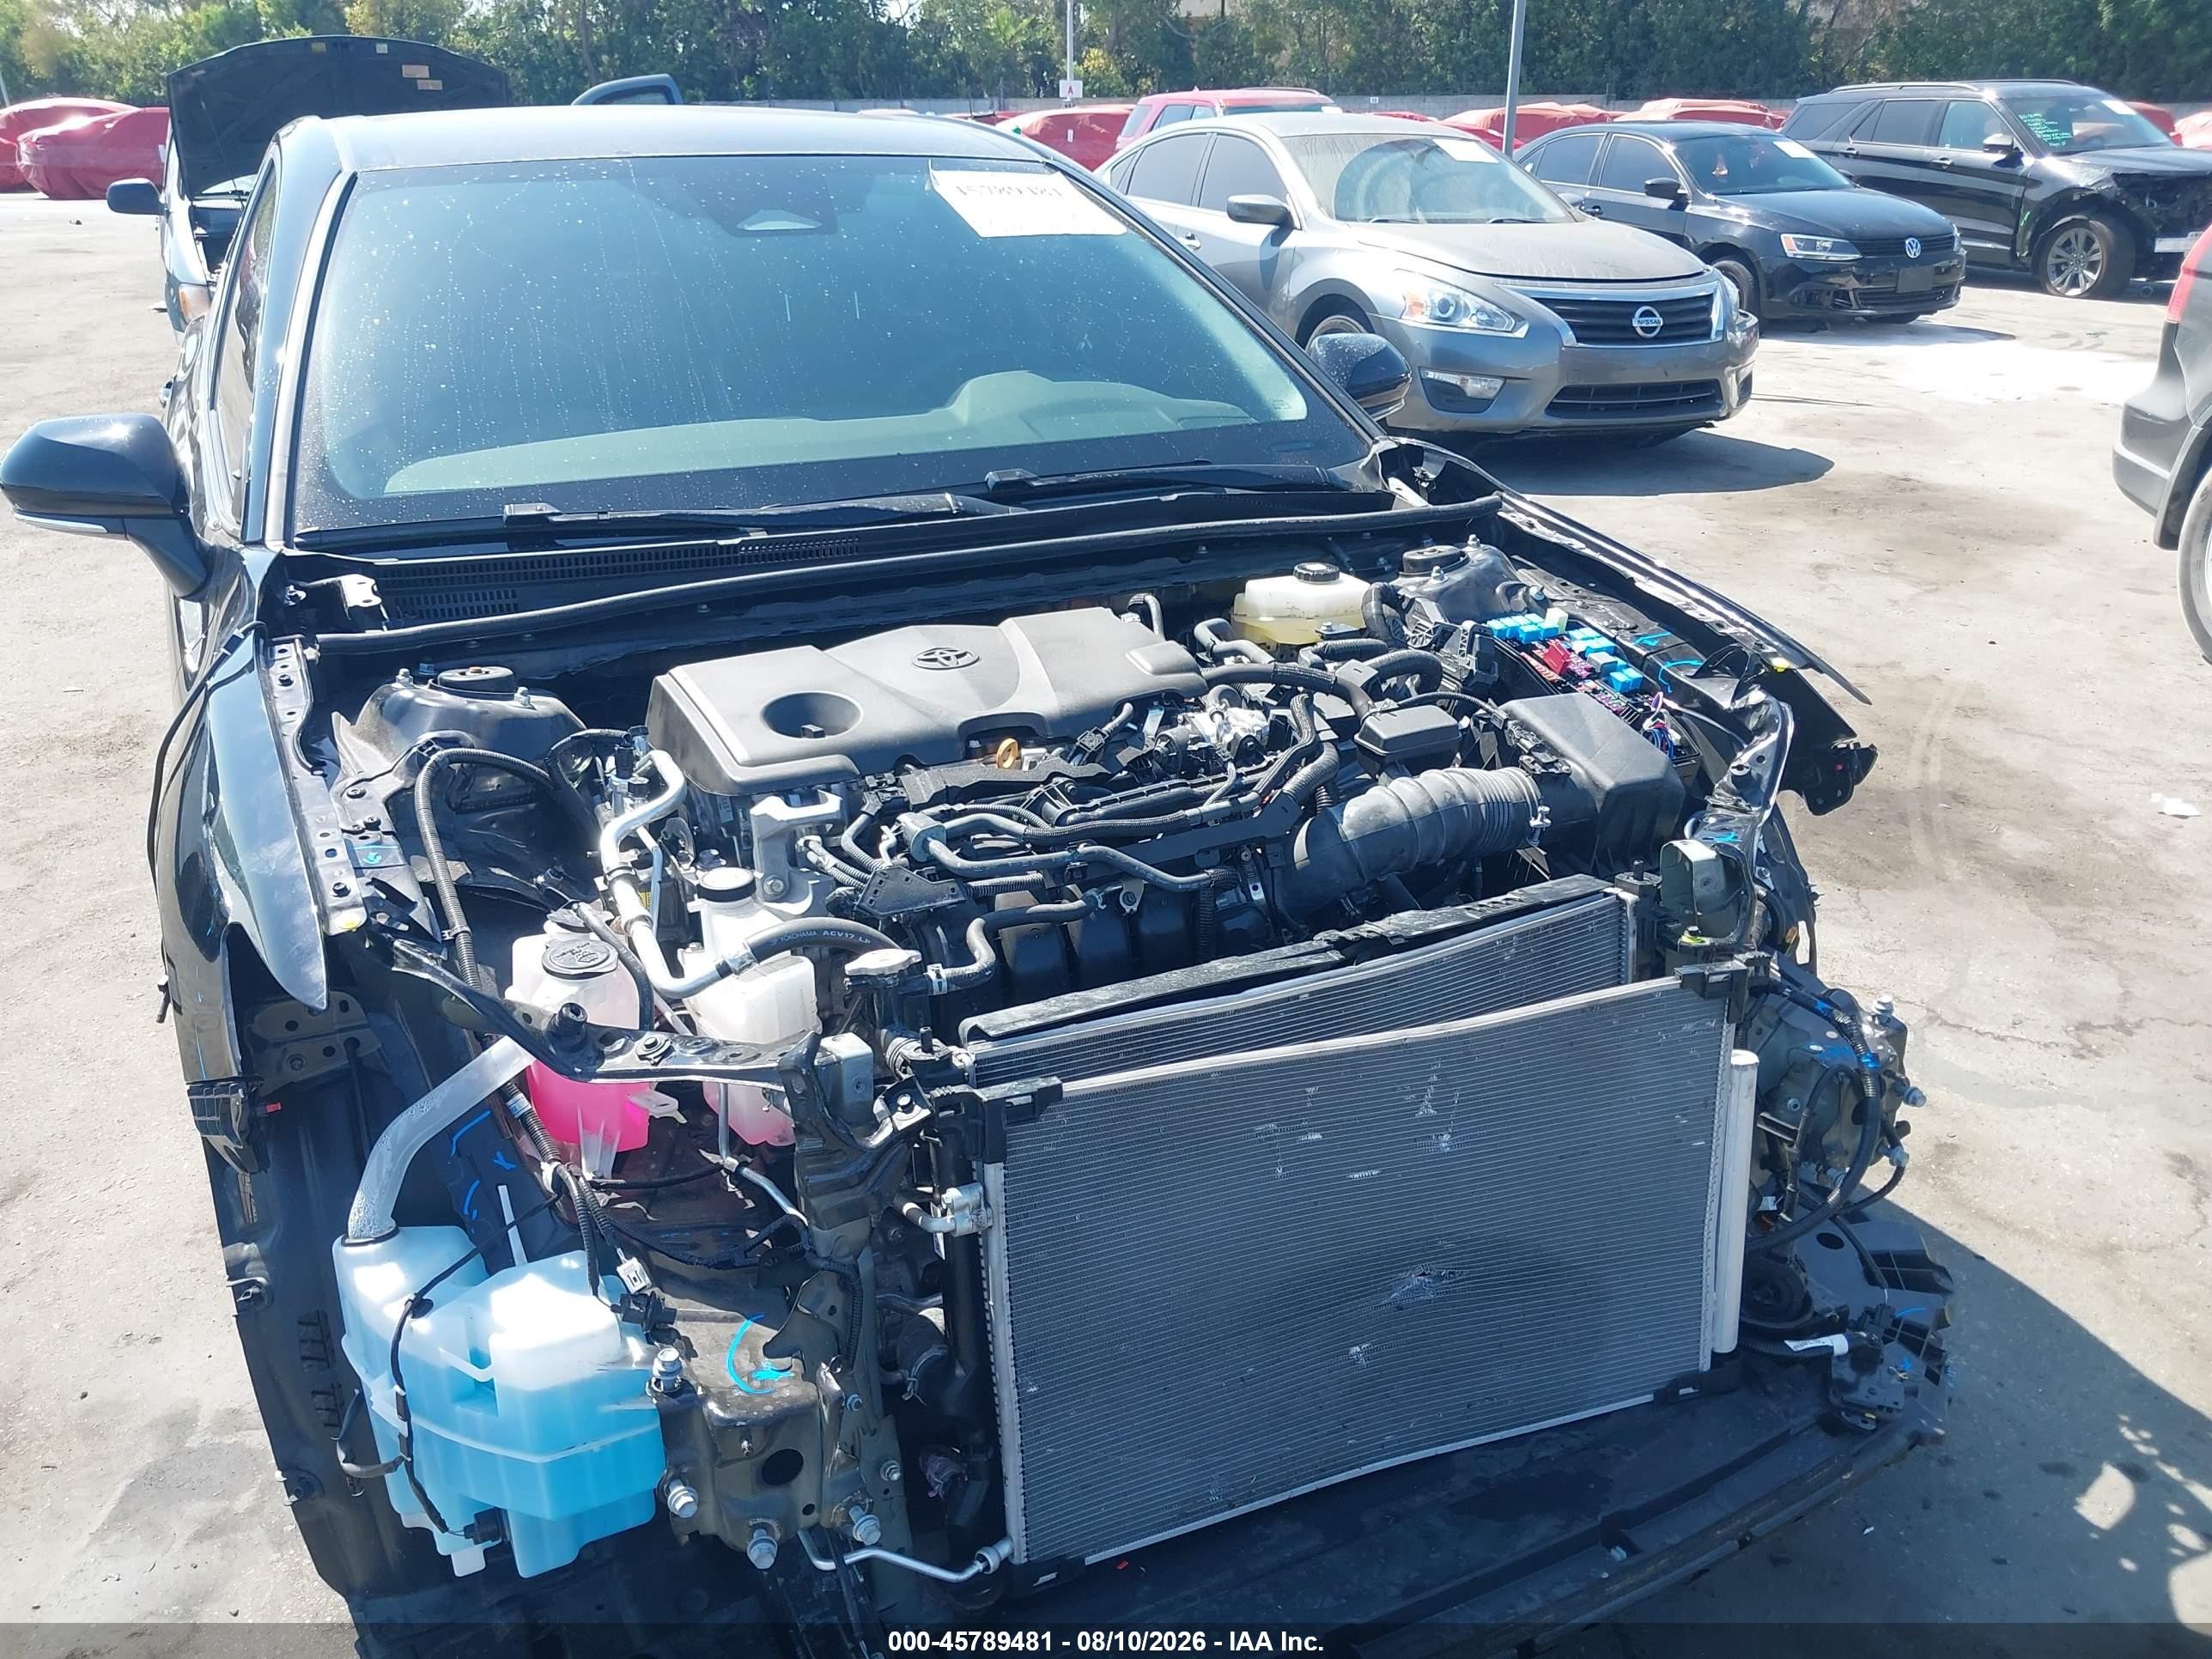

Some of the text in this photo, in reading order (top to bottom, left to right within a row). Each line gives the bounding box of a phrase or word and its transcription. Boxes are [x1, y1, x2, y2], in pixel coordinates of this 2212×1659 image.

[1067, 85, 1073, 95] A
[780, 929, 818, 942] YOKOHAMA
[822, 929, 855, 939] ACV17
